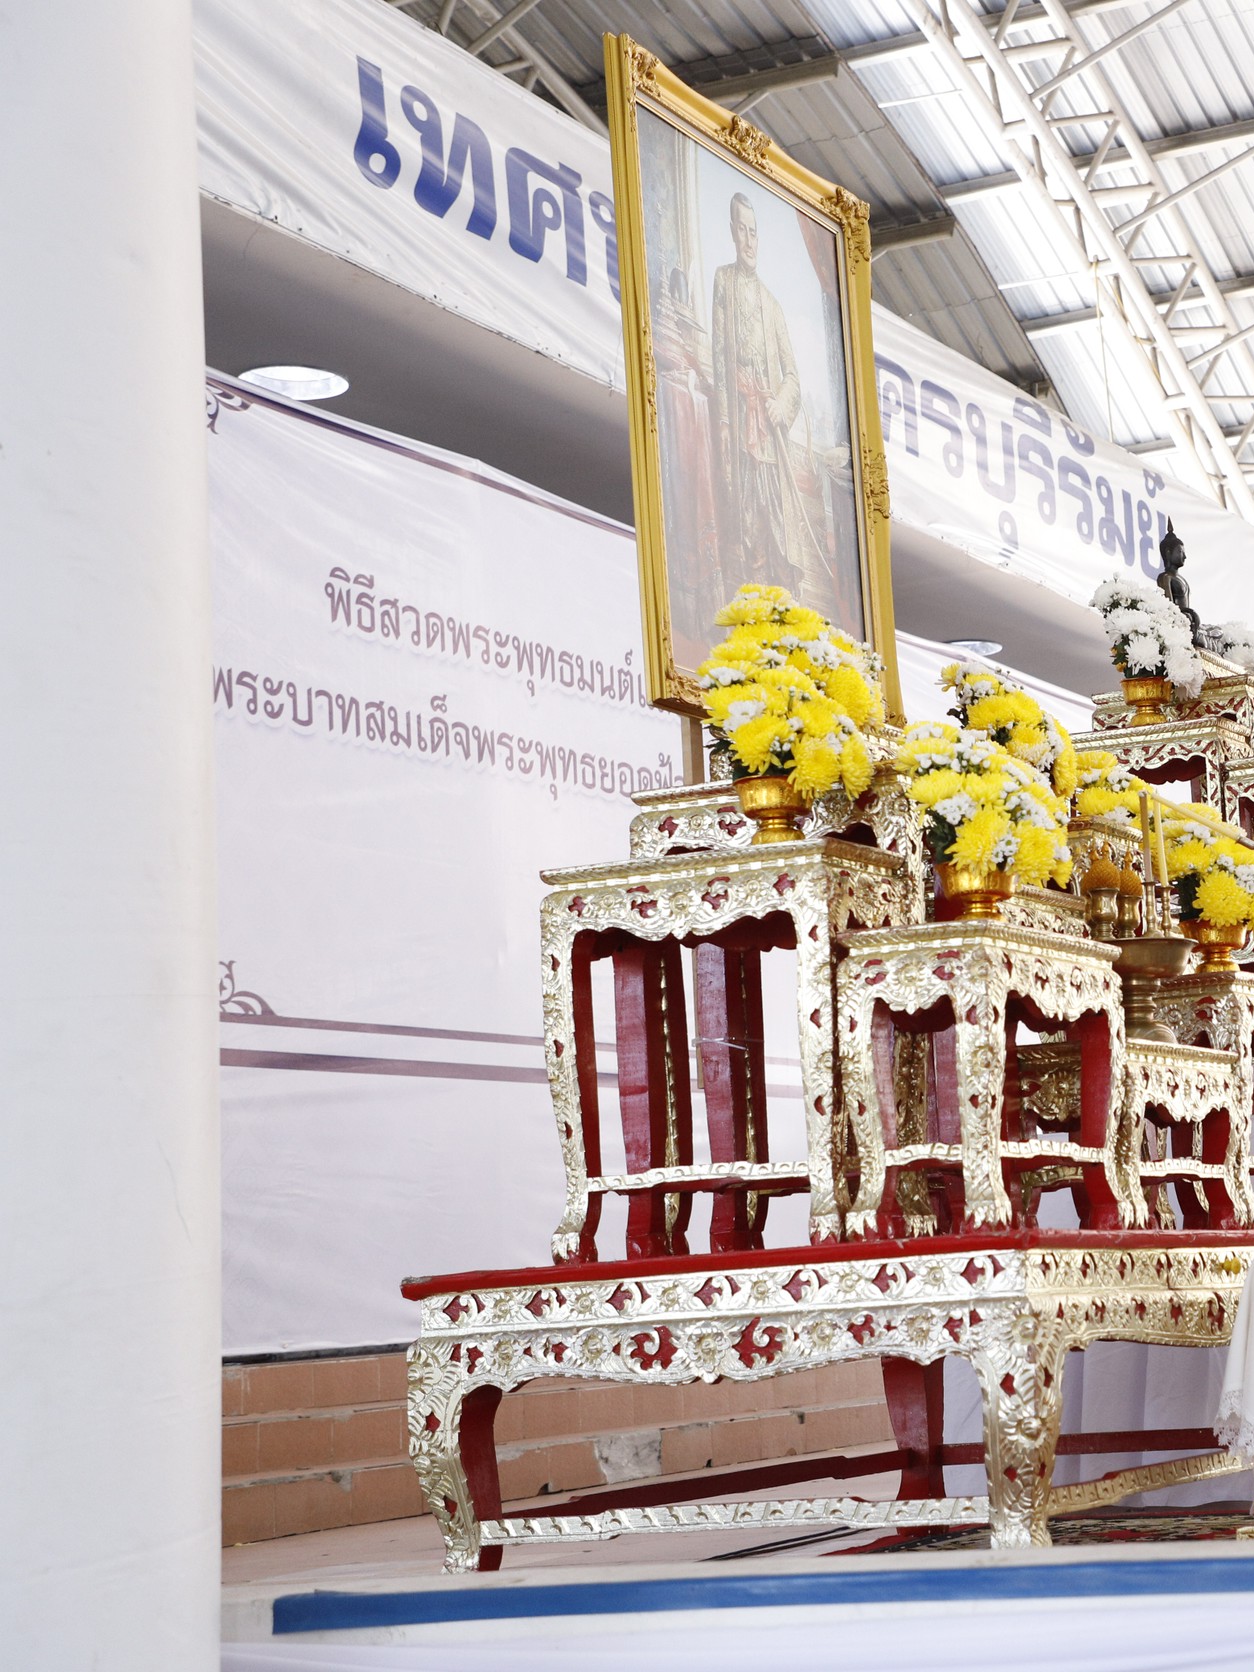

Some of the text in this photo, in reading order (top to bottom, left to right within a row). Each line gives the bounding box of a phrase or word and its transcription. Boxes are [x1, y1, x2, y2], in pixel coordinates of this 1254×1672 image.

[324, 566, 671, 715] พิธีสวดพระพุทธมนต์เ
